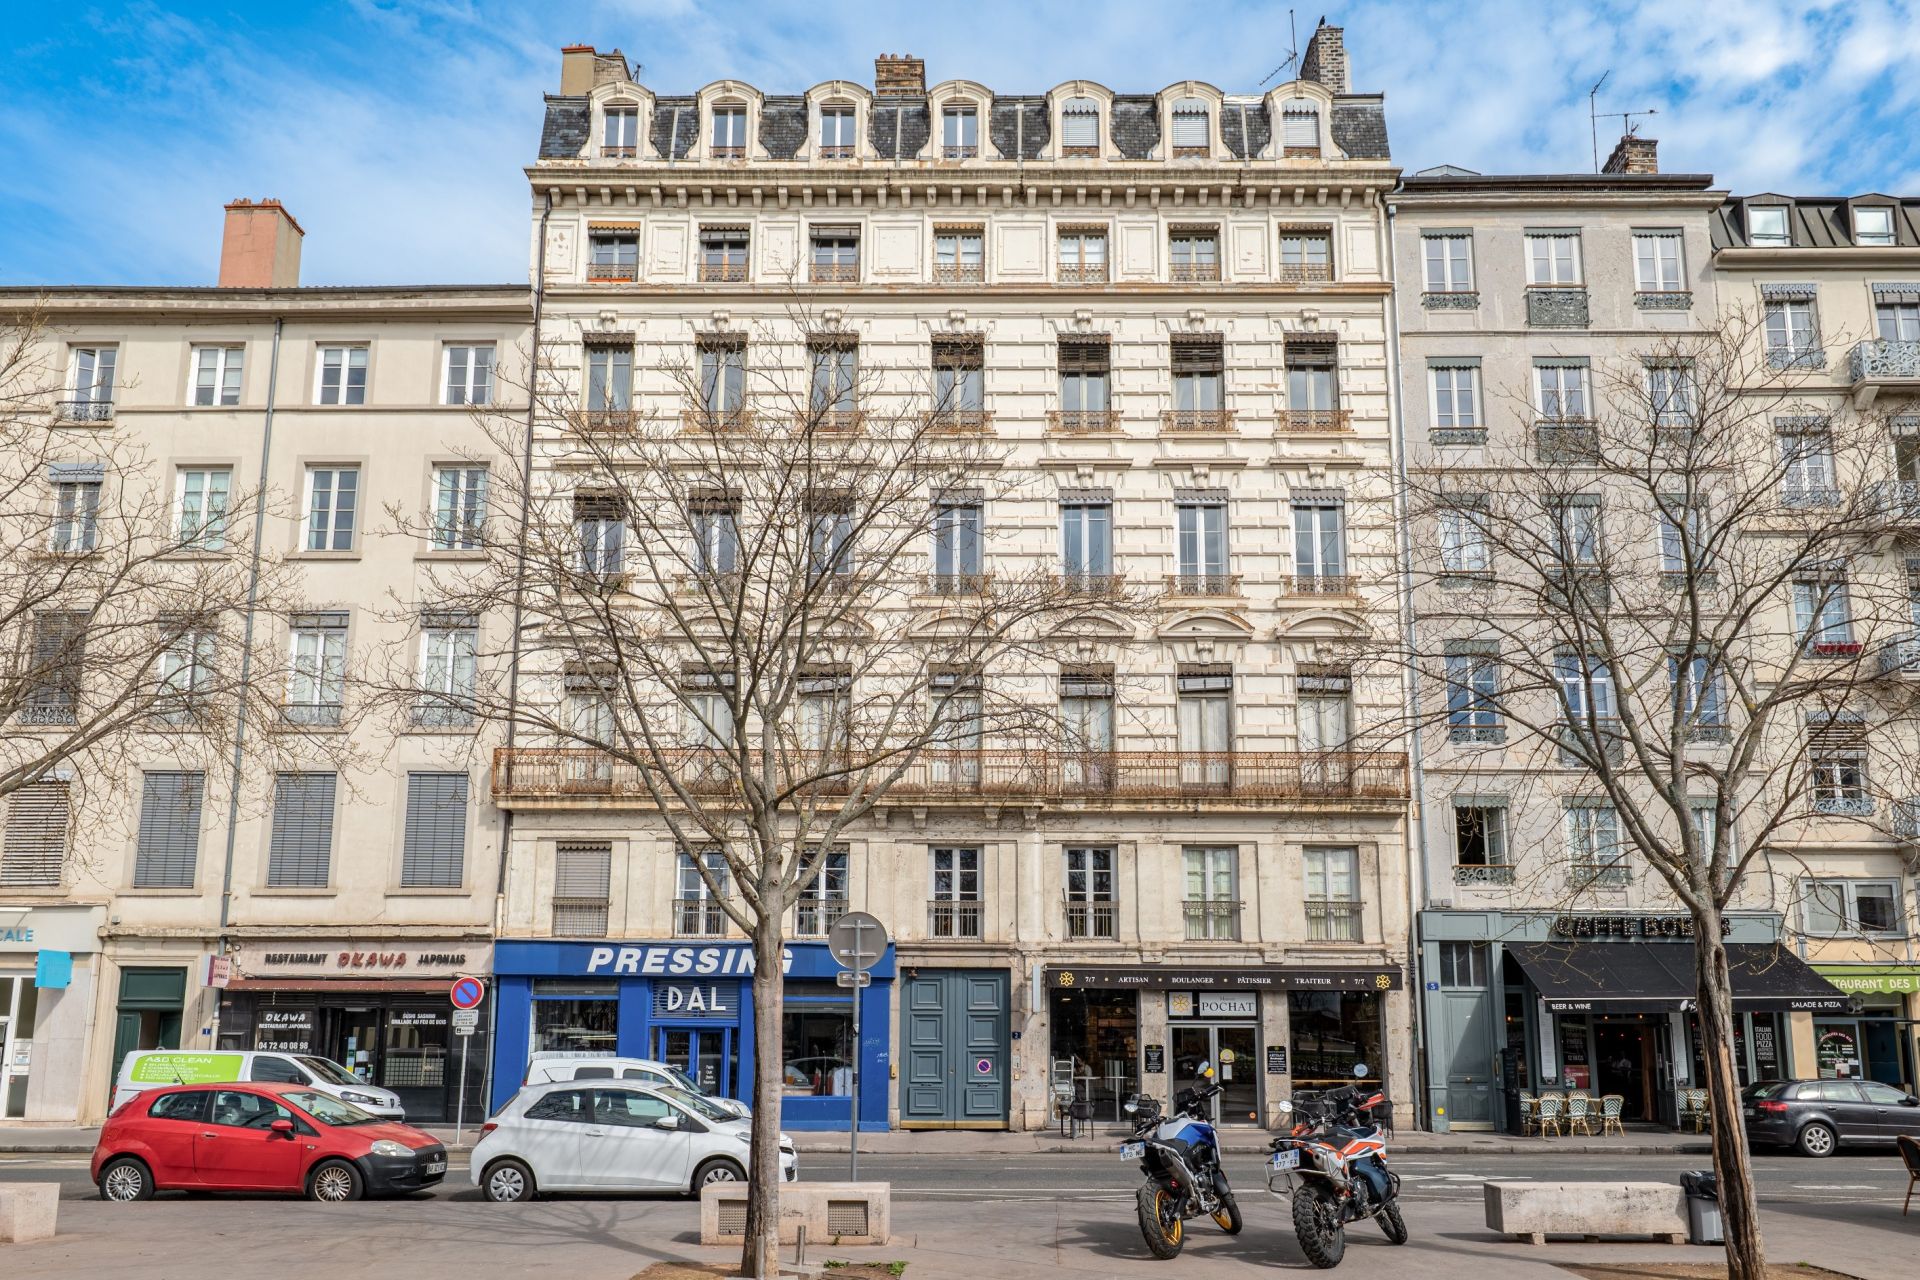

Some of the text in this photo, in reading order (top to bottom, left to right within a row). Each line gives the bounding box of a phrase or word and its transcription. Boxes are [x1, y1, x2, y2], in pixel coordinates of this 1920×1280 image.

[265, 952, 466, 967] RESTAURANT OKAWA JAPONAIS
[1237, 976, 1272, 984] PÂTISSIER
[1294, 977, 1331, 985] TRAITEUR
[1890, 979, 1910, 989] DES
[667, 987, 726, 1011] DAL
[1202, 1002, 1255, 1011] POCHAT
[266, 1013, 305, 1022] OKAWA
[1755, 1033, 1772, 1041] FOOD
[259, 1041, 267, 1049] 04
[269, 1041, 277, 1049] 72
